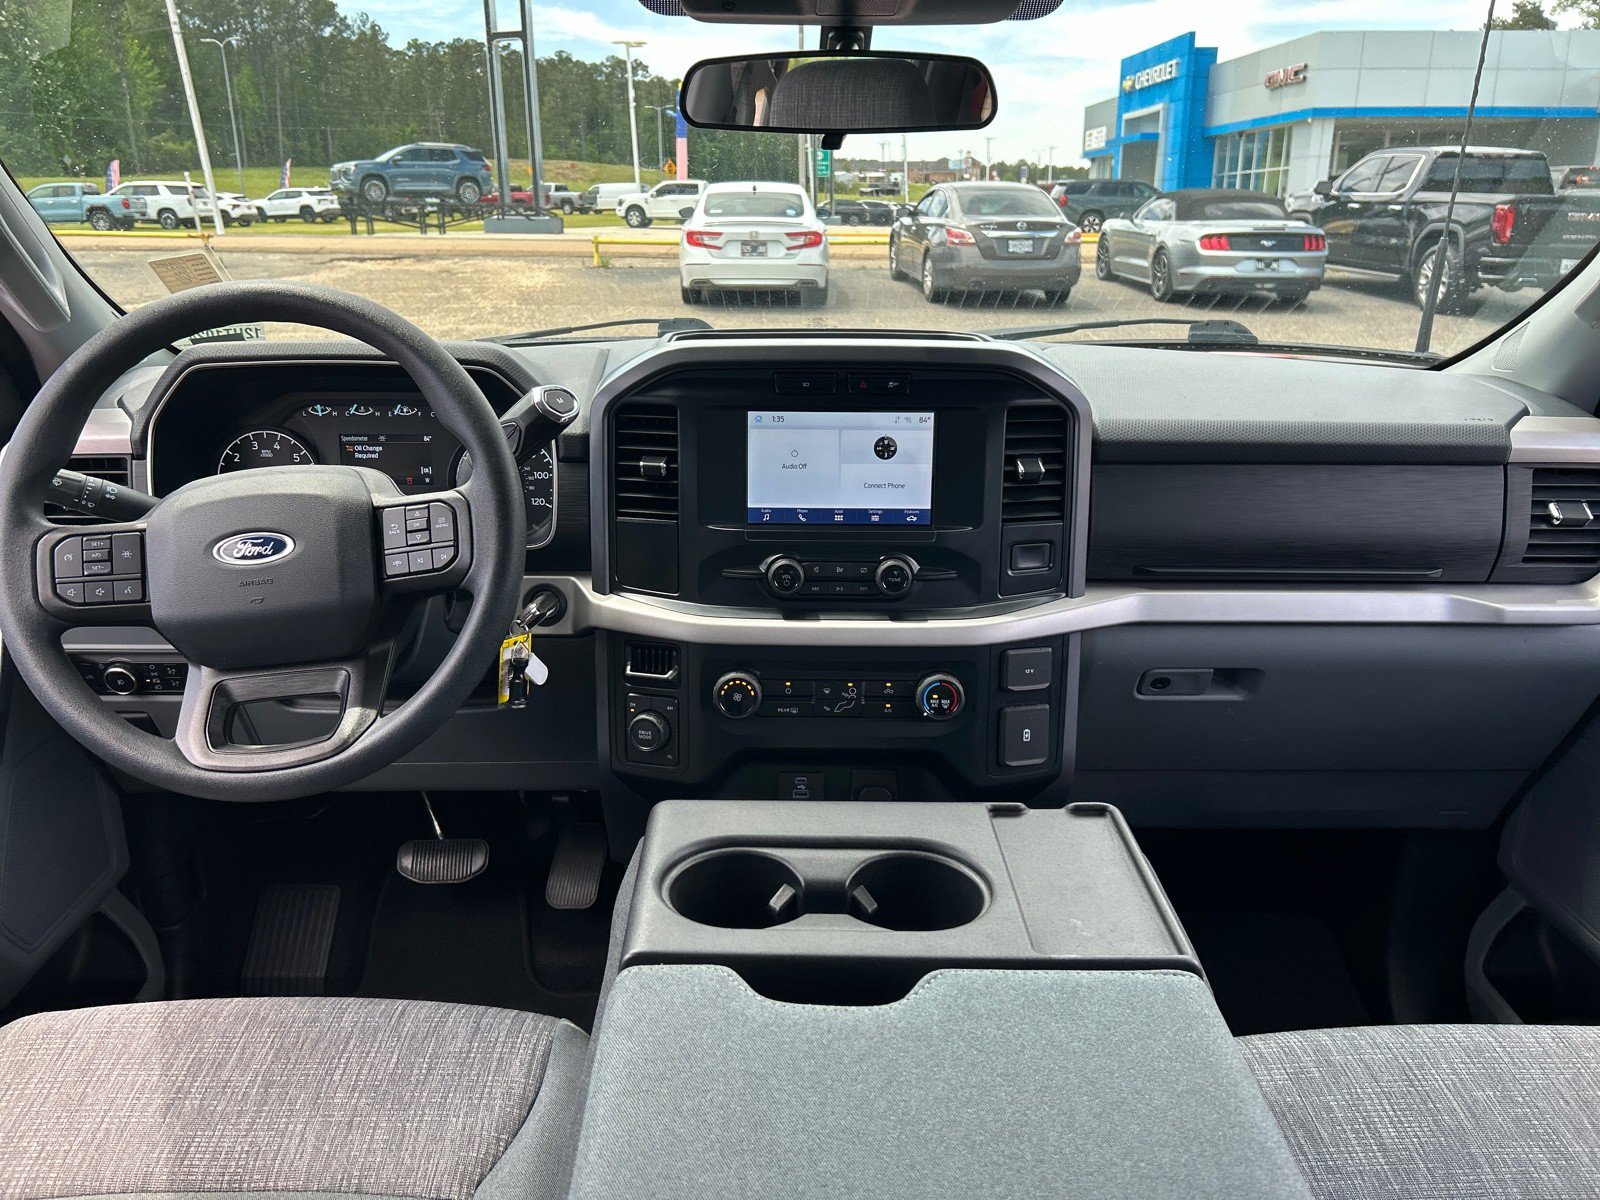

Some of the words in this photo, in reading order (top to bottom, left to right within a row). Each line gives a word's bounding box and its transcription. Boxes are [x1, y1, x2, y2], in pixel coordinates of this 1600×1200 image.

[1135, 60, 1179, 90] CHEVROLET
[1264, 63, 1307, 90] GMC
[771, 415, 785, 423] 1:35
[251, 441, 259, 450] 3
[273, 441, 280, 450] 4
[233, 453, 240, 462] 2
[293, 453, 300, 462] 5
[534, 471, 549, 479] 100
[531, 498, 545, 506] 120
[233, 538, 274, 558] Ford
[239, 578, 274, 587] AIRBAG
